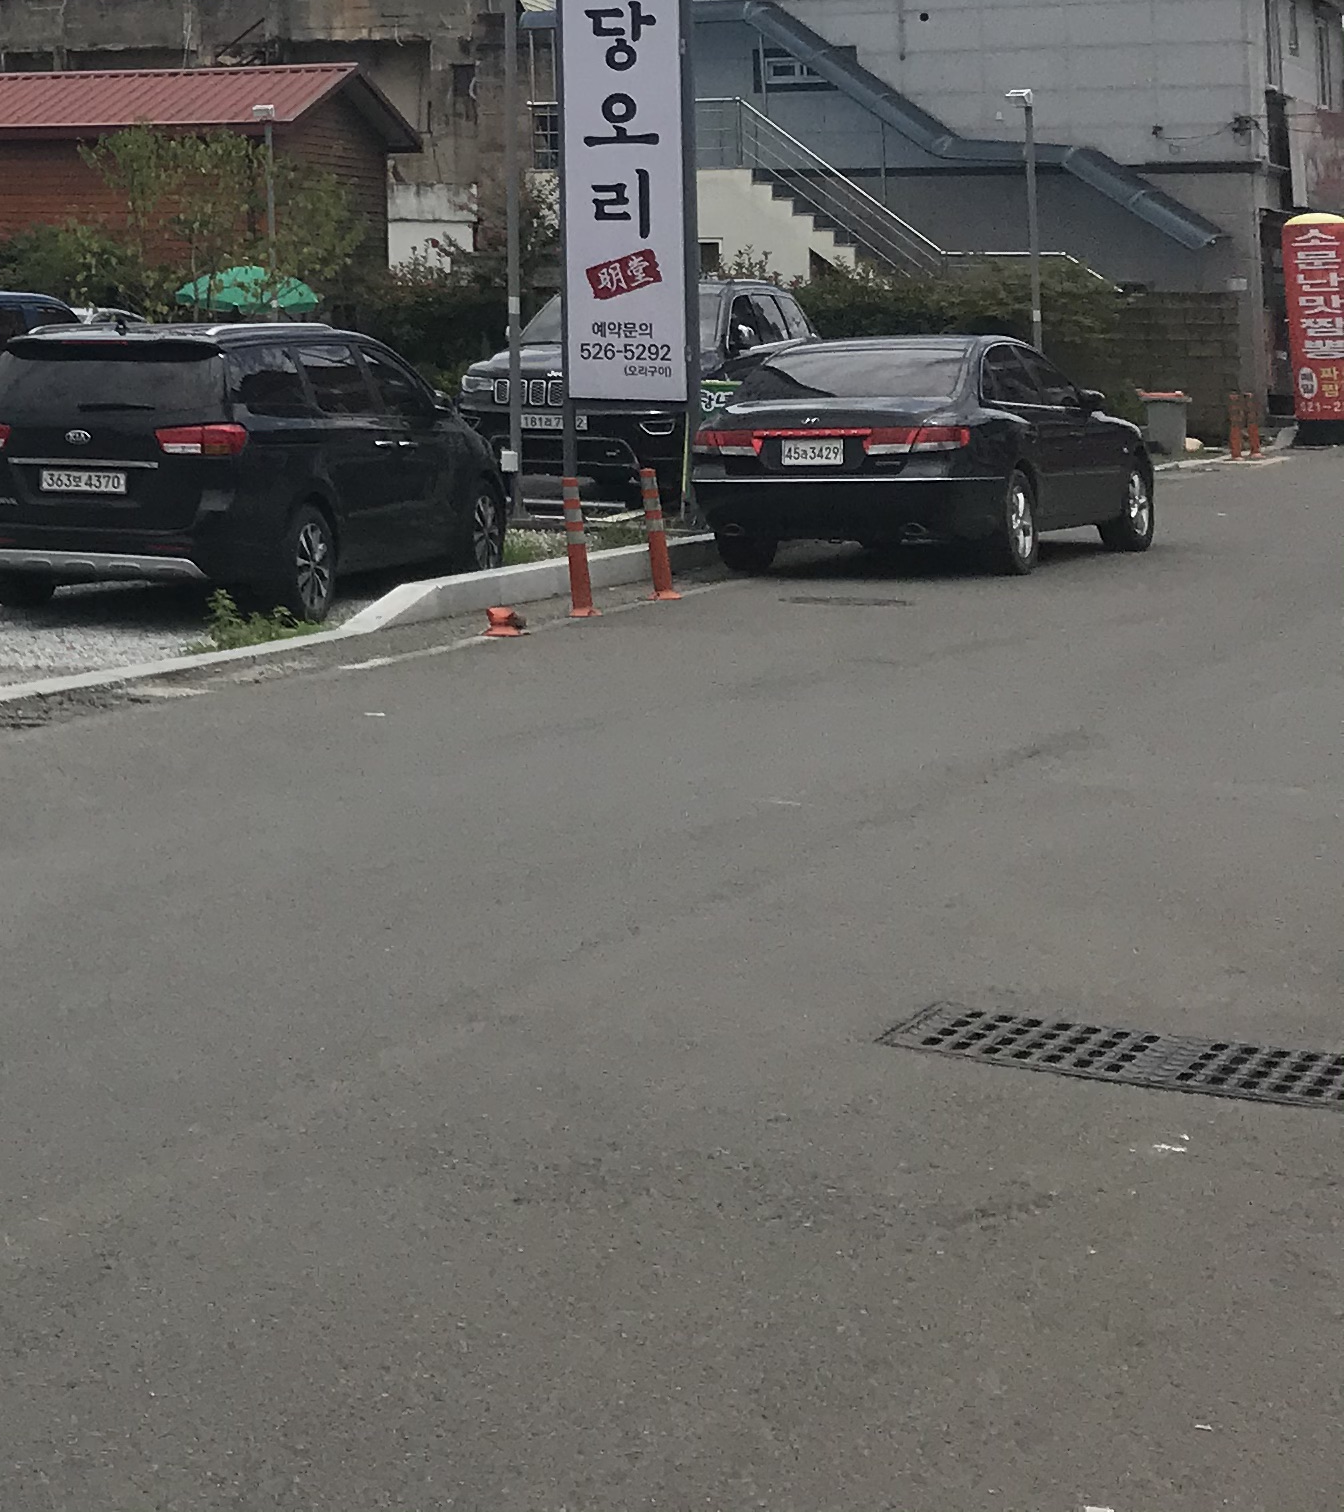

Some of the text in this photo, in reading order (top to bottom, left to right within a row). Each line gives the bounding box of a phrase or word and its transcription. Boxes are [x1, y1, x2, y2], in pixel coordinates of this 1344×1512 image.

[597, 255, 654, 292] 明堂
[592, 321, 653, 339] 예약문의
[580, 343, 672, 362] 526-5292
[624, 365, 672, 378] (오리구이)
